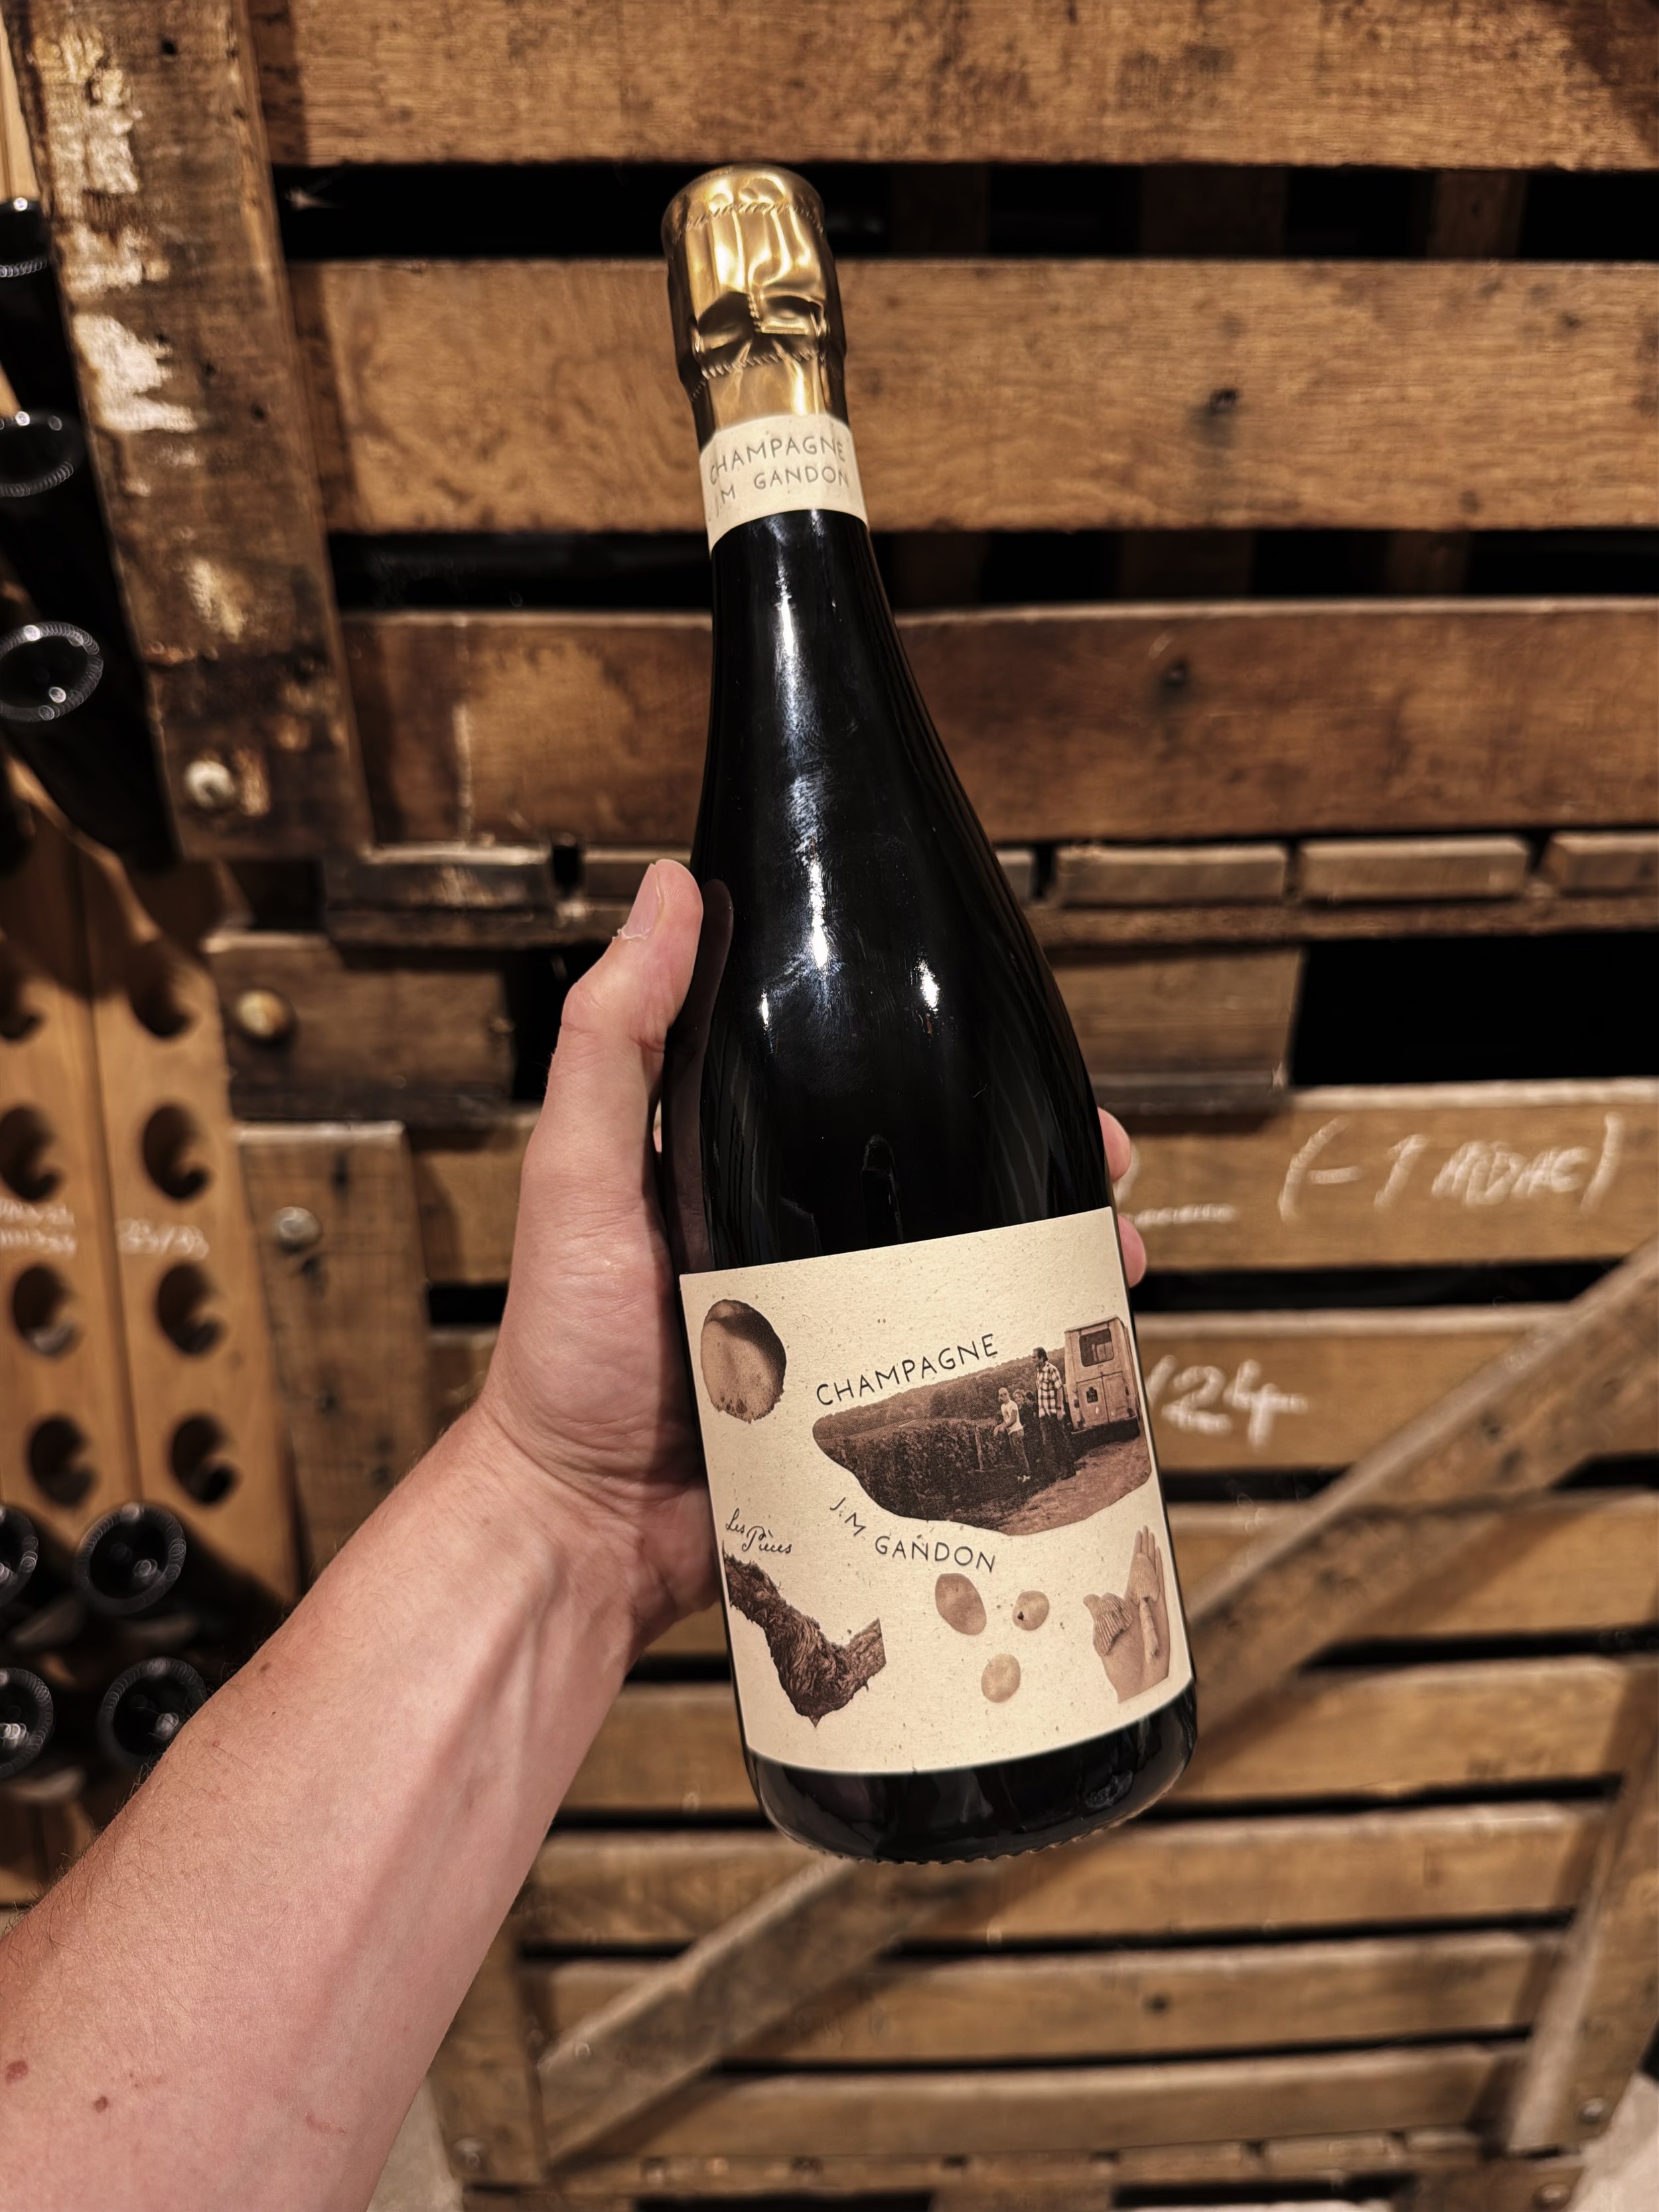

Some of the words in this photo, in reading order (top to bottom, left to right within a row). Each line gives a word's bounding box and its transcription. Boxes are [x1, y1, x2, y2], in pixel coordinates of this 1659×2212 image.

[709, 435, 846, 485] CHAMPAGNE
[754, 465, 850, 490] GANDON
[816, 1333, 999, 1406] CHAMPAGNE
[725, 1507, 746, 1534] Les
[741, 1525, 792, 1554] Pièces
[874, 1535, 996, 1574] GANDON
